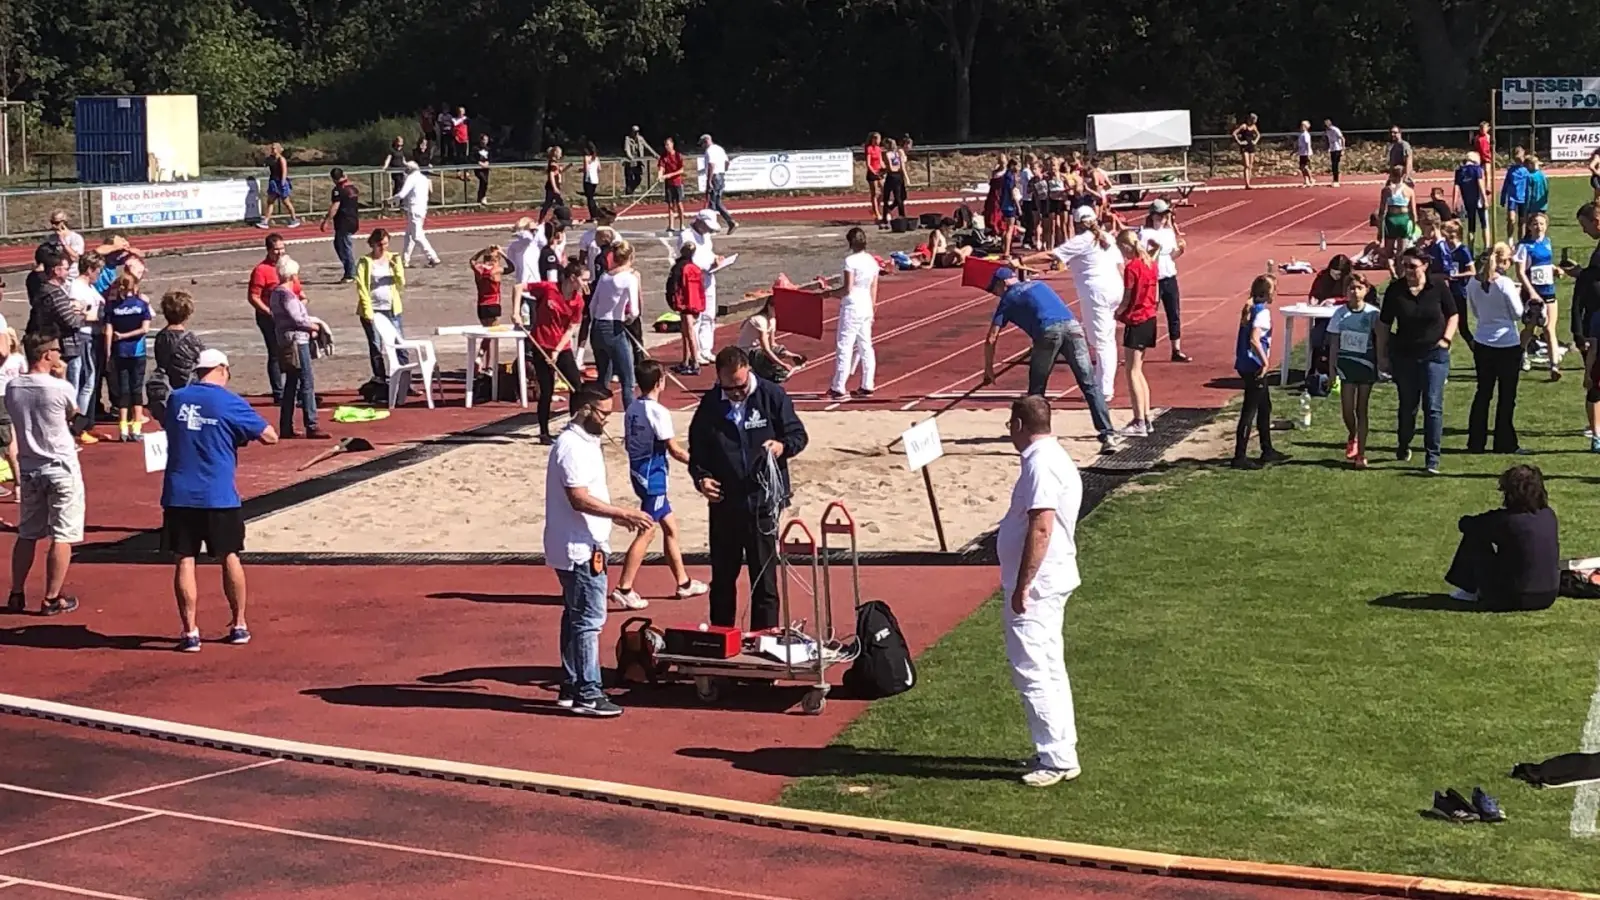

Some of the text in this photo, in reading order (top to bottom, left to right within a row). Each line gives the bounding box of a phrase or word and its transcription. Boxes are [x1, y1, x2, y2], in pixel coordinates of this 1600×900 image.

[1504, 79, 1583, 92] FLIESEN
[1572, 94, 1600, 107] PO
[1557, 133, 1600, 144] VERMES
[110, 189, 188, 201] Rocco Kleeberg
